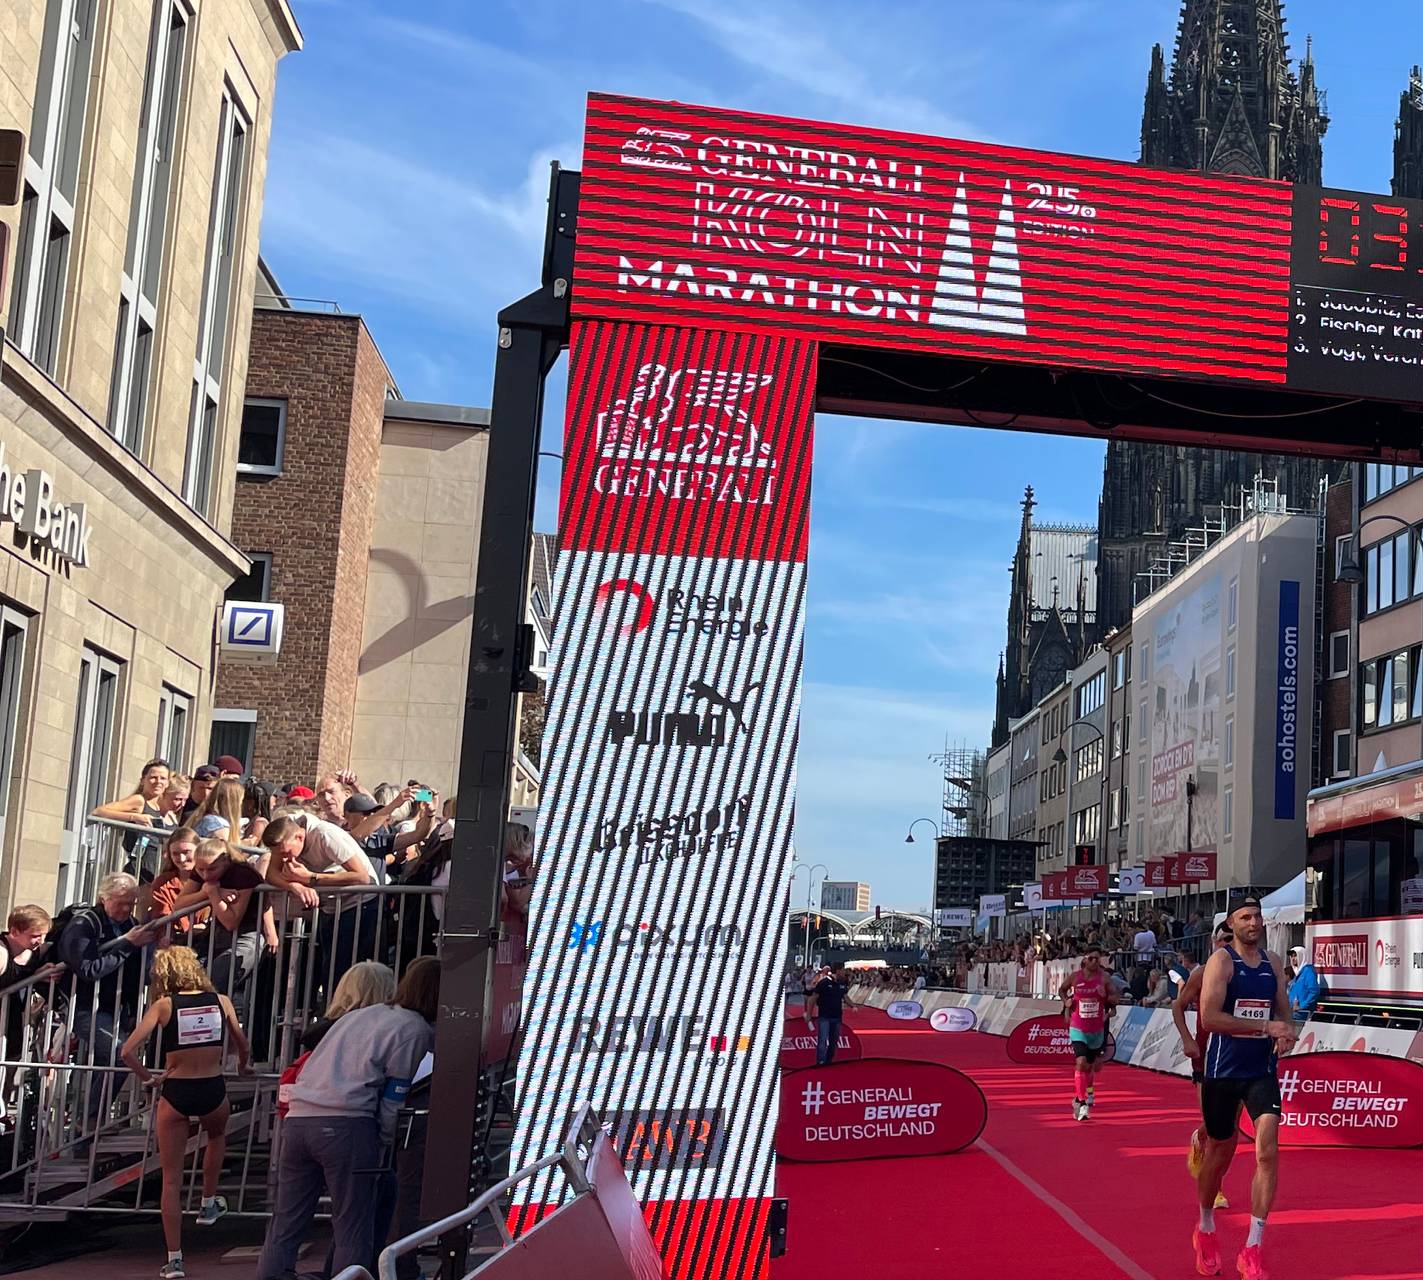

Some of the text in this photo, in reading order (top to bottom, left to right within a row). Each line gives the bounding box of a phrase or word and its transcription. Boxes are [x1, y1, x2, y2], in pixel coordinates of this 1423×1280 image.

[698, 136, 923, 194] GENERALI
[1023, 220, 1094, 241] EDITION
[618, 255, 920, 322] MARATHON
[595, 465, 775, 505] GENERALI
[34, 469, 94, 568] Bank
[667, 587, 743, 612] Rhein
[666, 613, 769, 642] Energie
[1277, 626, 1297, 772] aohostels.com
[608, 711, 725, 748] PUMA
[1325, 942, 1367, 968] GENERALI
[196, 1016, 205, 1024] 2
[1241, 1009, 1264, 1018] 4169
[573, 1015, 704, 1052] REWE
[864, 1103, 942, 1121] BEWEGT
[1331, 1097, 1408, 1112] BEWEGT
[805, 1121, 935, 1142] DEUTSCHLAND
[1278, 1112, 1398, 1129] DEUTSCHLAND
[626, 1118, 714, 1161] AWB
